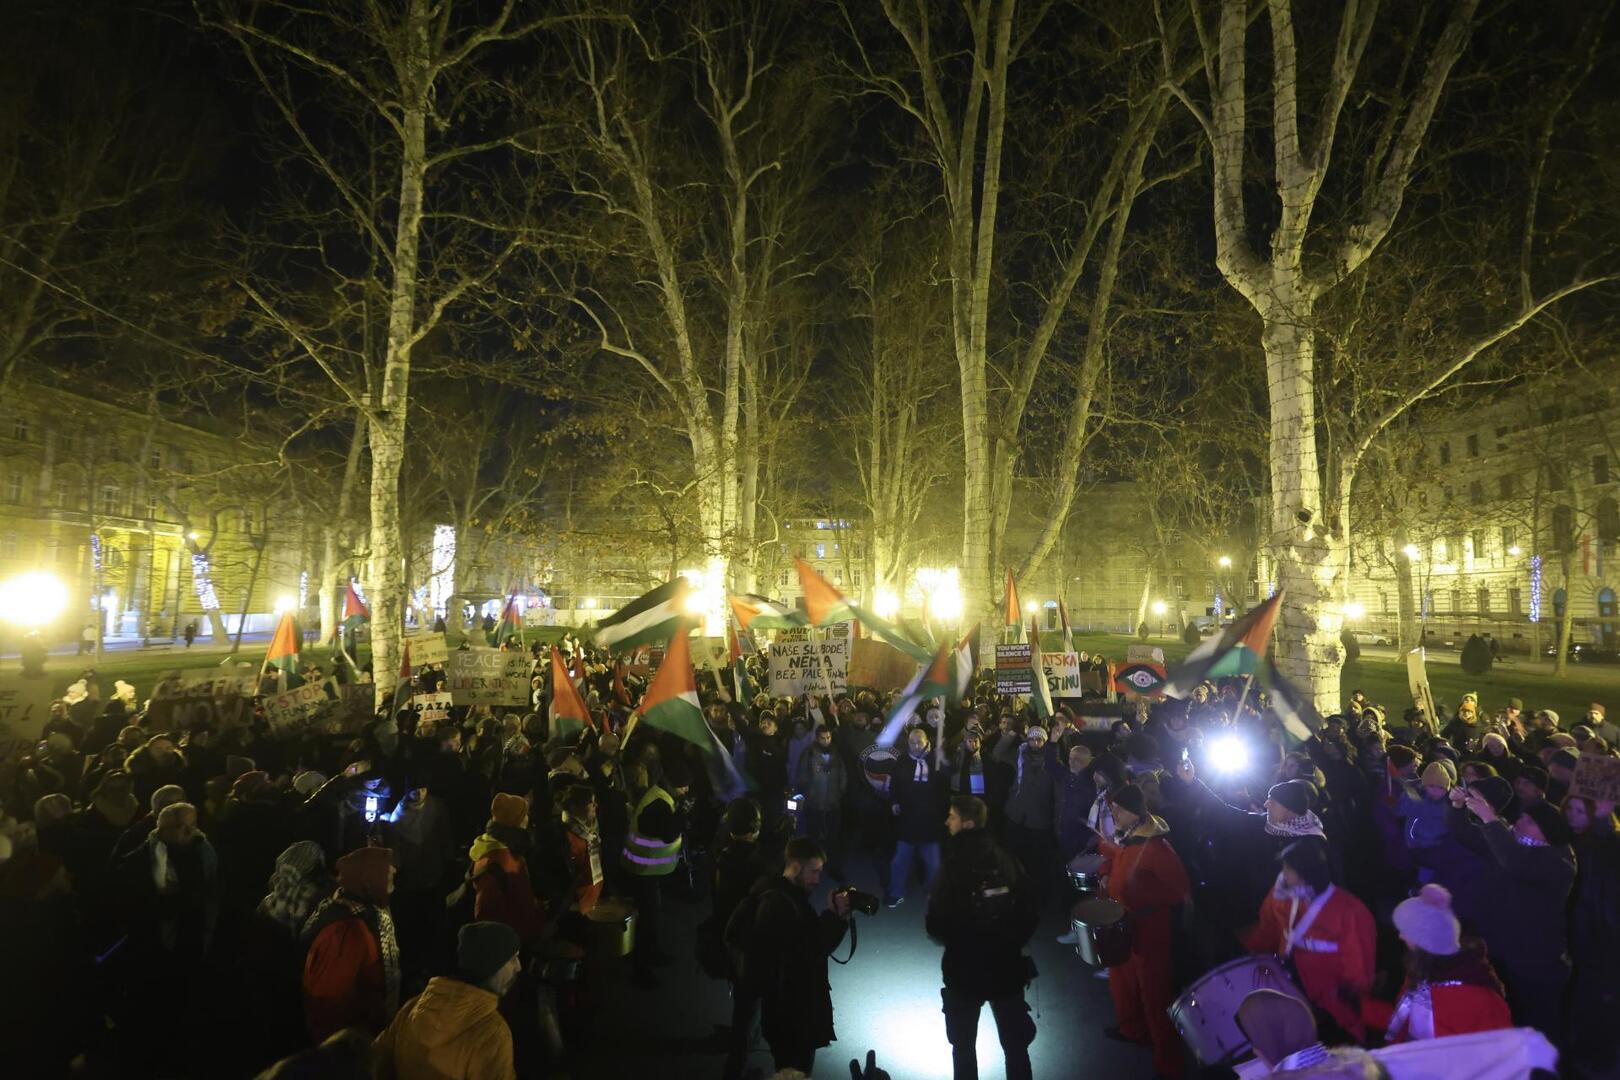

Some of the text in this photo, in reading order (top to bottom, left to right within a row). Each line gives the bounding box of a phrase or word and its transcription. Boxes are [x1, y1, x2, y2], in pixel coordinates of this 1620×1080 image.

[803, 643, 842, 655] SLBODE
[457, 652, 502, 668] PEACE
[789, 655, 833, 669] NEMA
[1042, 654, 1077, 668] ATSKA
[775, 669, 797, 680] BEZ
[997, 686, 1031, 694] PALESTINE
[1047, 675, 1080, 692] STINU
[275, 684, 321, 709] STOP
[415, 701, 453, 712] GAZA
